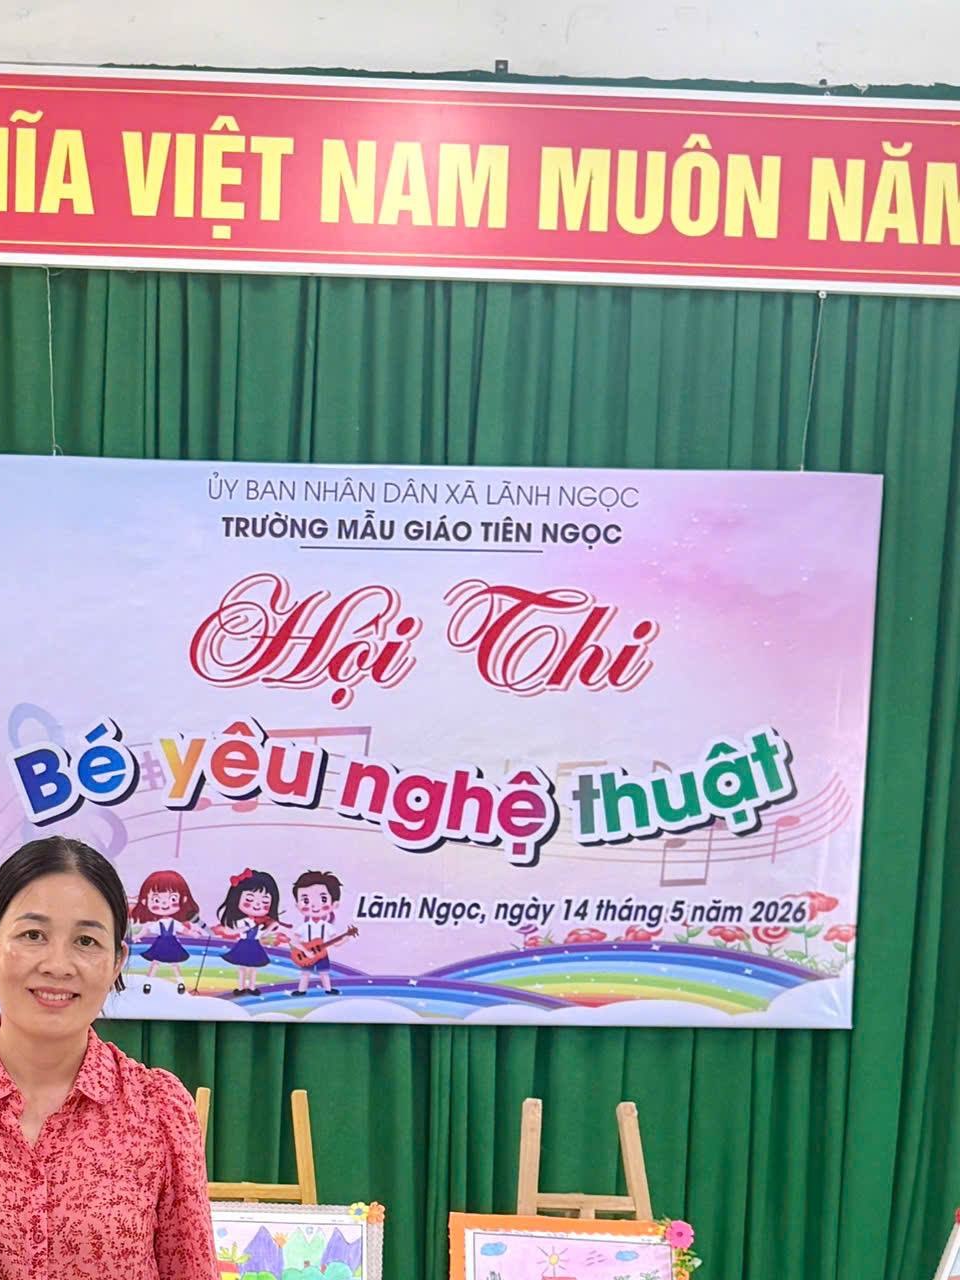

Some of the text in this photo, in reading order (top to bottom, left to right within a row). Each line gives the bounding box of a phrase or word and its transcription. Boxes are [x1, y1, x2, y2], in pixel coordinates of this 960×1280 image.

[123, 116, 293, 239] VIỆT
[321, 139, 508, 228] NAM
[539, 134, 780, 238] MUÔN
[207, 471, 640, 512] ỦY BAN NHÂN DÂN XÃ LÃNH NGỌC
[221, 509, 622, 550] TRƯỜNG MẪU GIÁO TIÊN NGỌC
[188, 572, 660, 711] Hội Thi
[11, 718, 788, 862] Bé yêu nghệ thuật
[356, 895, 807, 928] Lãnh Ngọc, ngày 14 tháng 5 năm 2026
